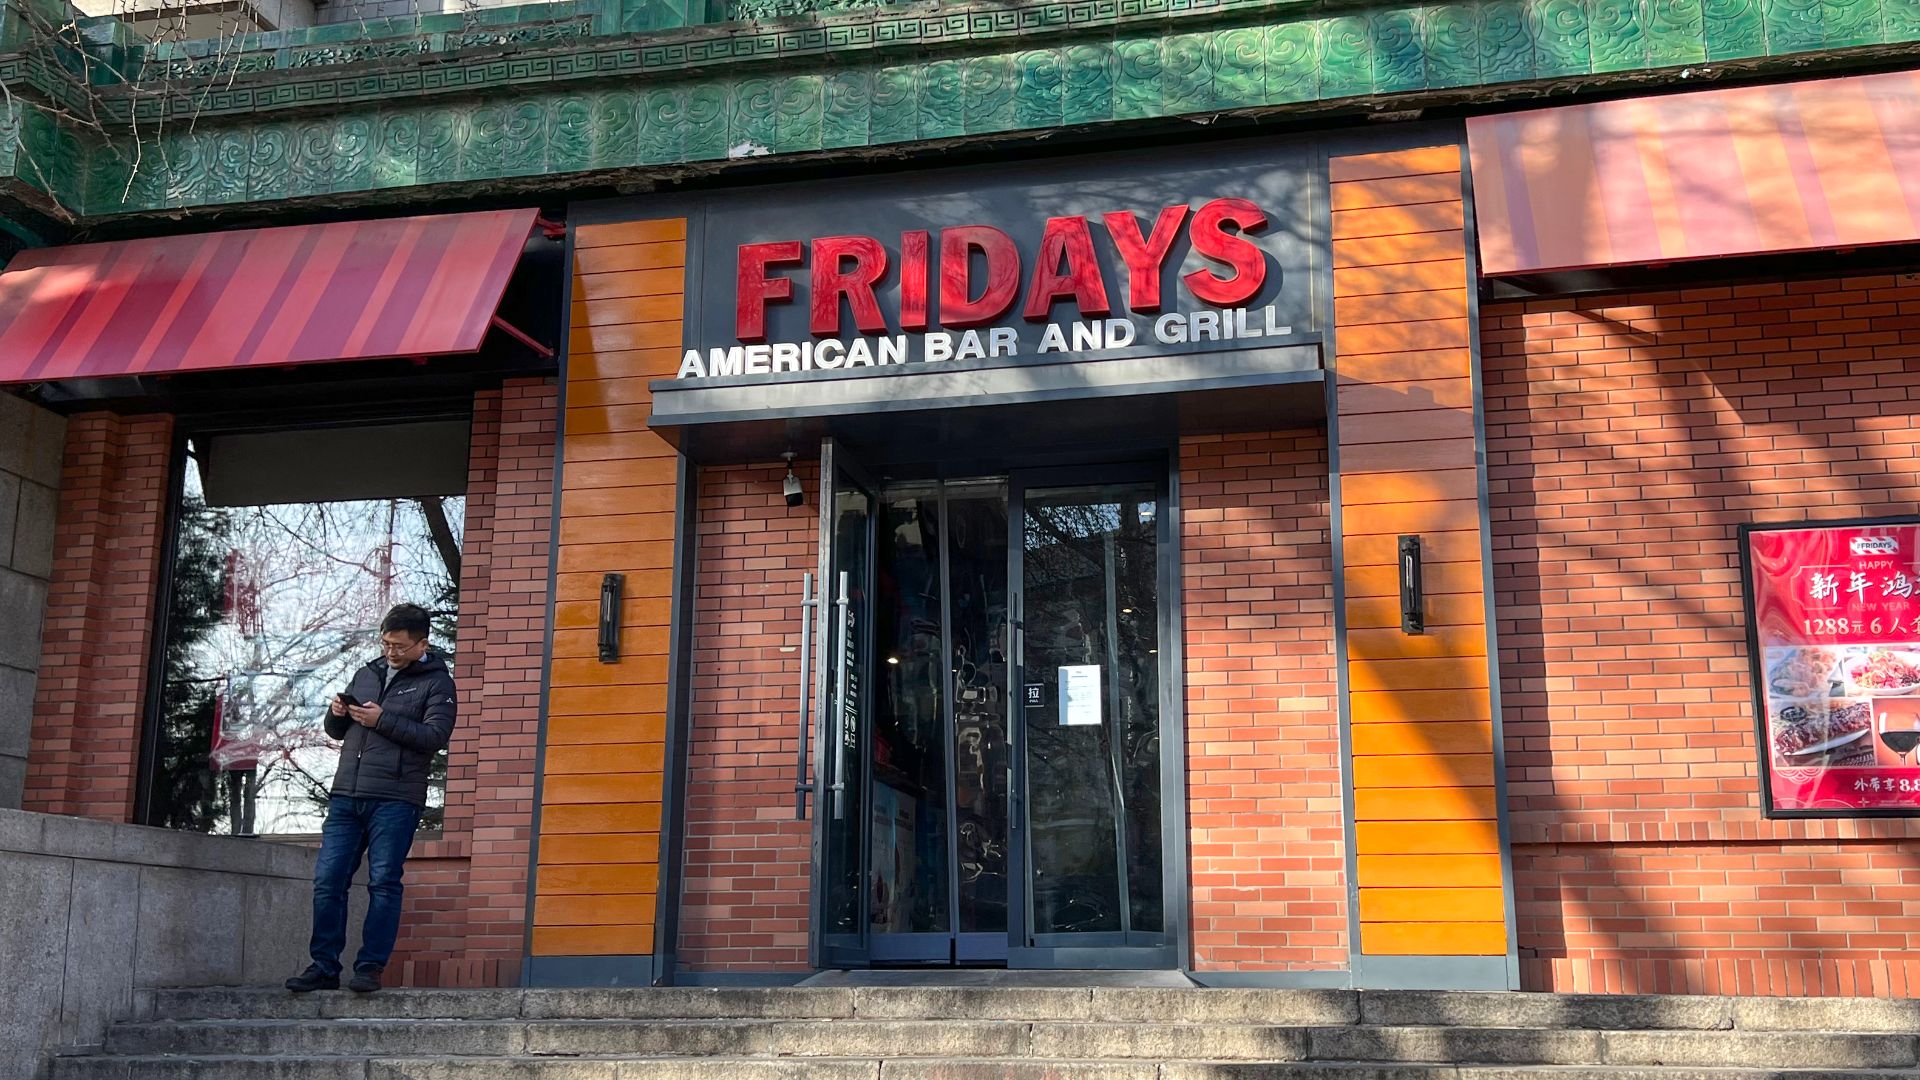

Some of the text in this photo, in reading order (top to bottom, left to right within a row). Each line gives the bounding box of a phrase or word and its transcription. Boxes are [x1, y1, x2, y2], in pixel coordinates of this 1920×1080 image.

[736, 198, 1267, 341] FRIDAYS
[677, 304, 1292, 379] AMERICAN BAR AND GRILL
[1861, 541, 1892, 549] FRIDAYS
[1859, 560, 1893, 569] HAPPY
[1809, 571, 1920, 606] 新年鸿
[1851, 601, 1910, 612] NEW YEAR
[1028, 687, 1039, 698] 拉
